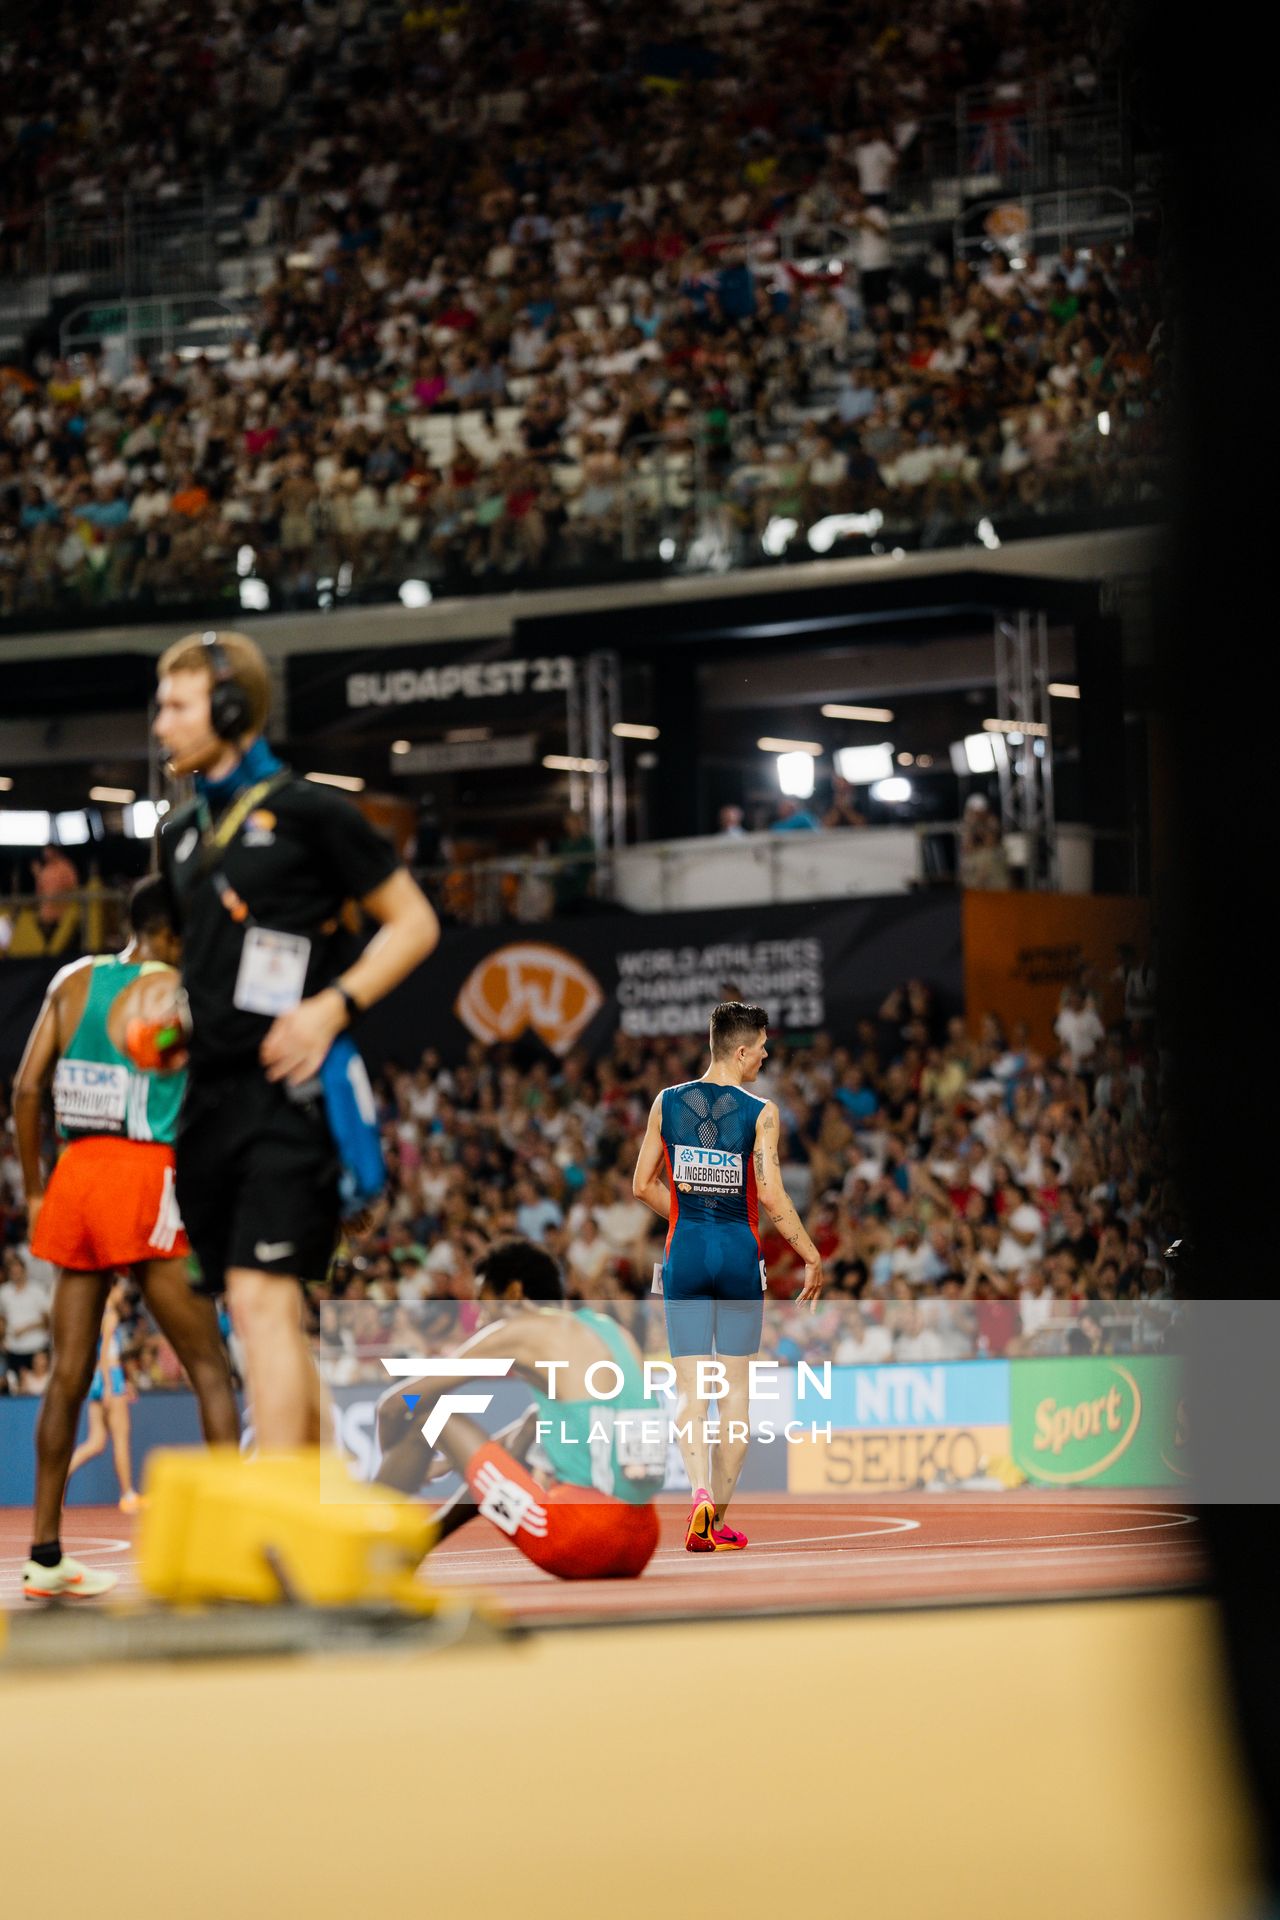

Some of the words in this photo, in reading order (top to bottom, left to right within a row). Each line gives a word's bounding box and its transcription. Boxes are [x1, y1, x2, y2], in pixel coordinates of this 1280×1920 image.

[346, 659, 529, 708] BUDAPEST
[531, 655, 575, 692] 23
[616, 946, 697, 977] WORLD
[700, 937, 822, 971] ATHLETICS
[785, 994, 824, 1027] 23
[675, 1166, 683, 1180] J.
[684, 1166, 740, 1184] INGEBRIGTSEN
[694, 1150, 738, 1168] TDK
[693, 1185, 729, 1194] BUDAPEST
[856, 1366, 946, 1424] NTN
[1033, 1383, 1123, 1455] Sport
[824, 1430, 979, 1486] SEIKO
